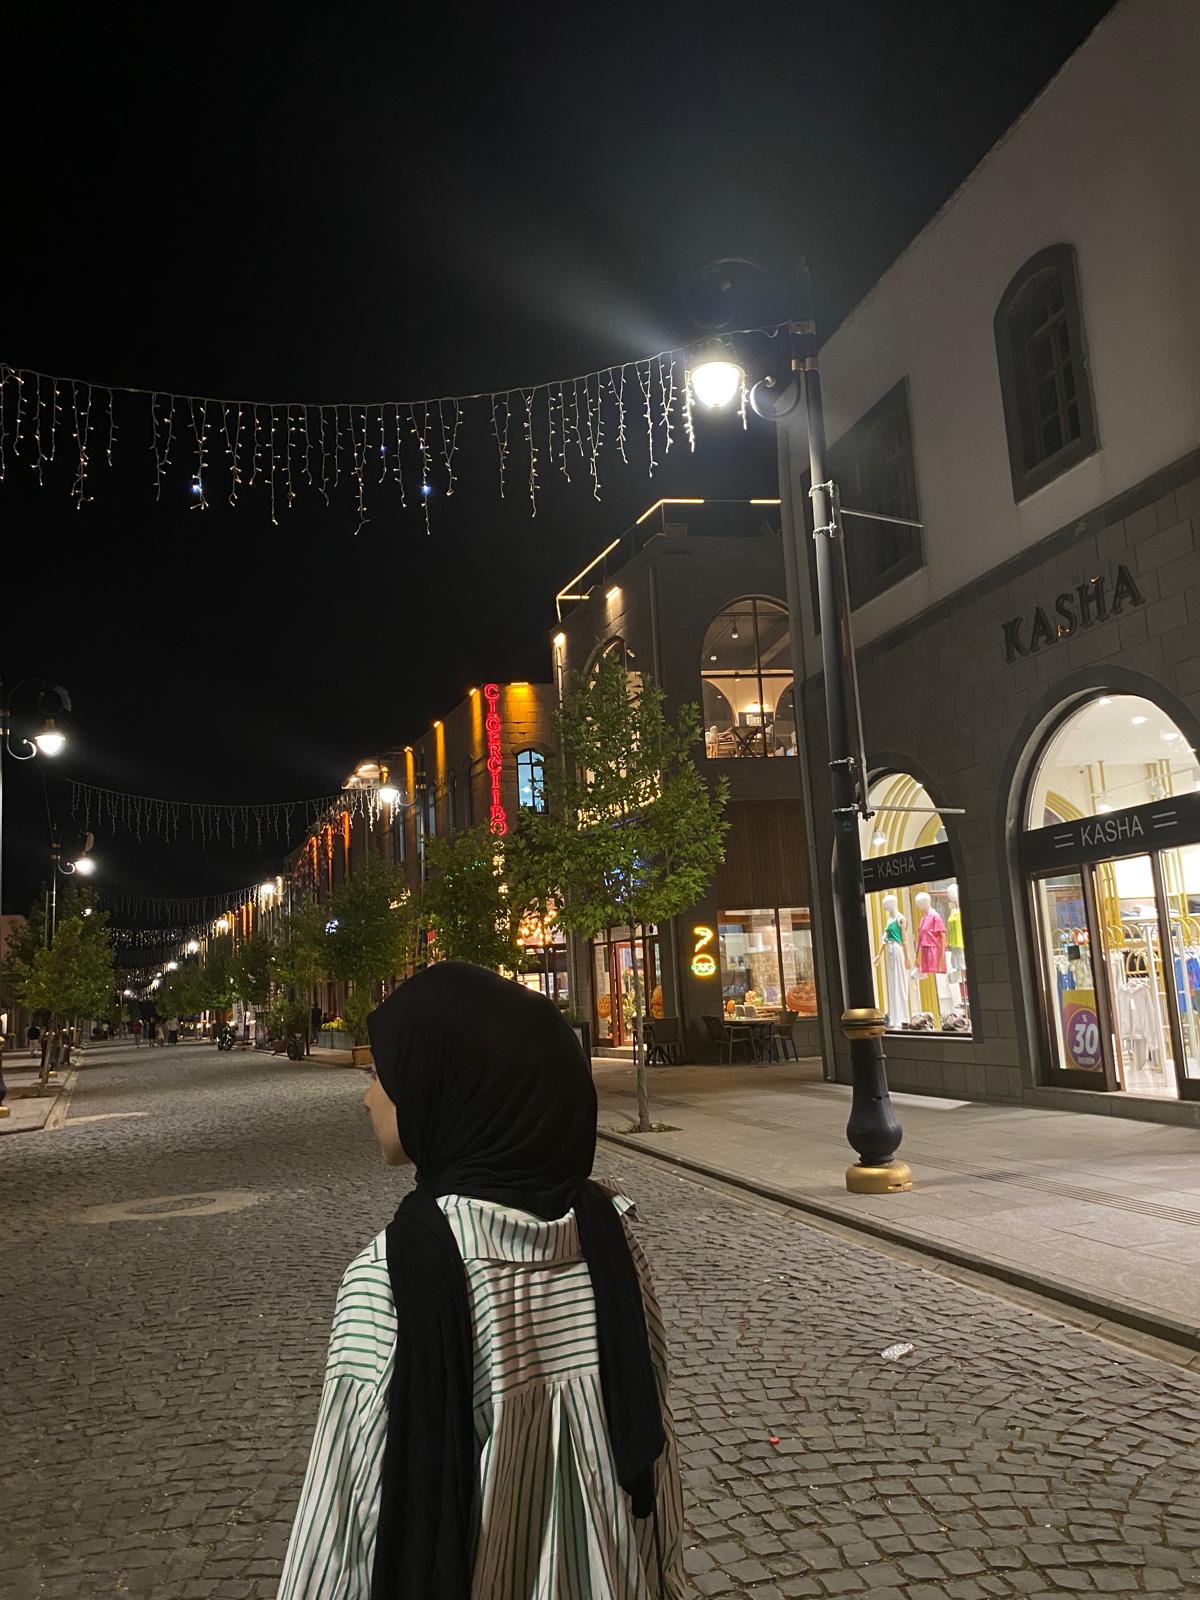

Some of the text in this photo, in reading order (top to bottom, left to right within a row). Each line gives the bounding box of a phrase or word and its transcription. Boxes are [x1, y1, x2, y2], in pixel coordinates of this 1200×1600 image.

[1002, 565, 1145, 663] KASHA
[1080, 814, 1144, 847] KASHA
[877, 854, 916, 879] KASHA
[1073, 1024, 1098, 1054] 30
